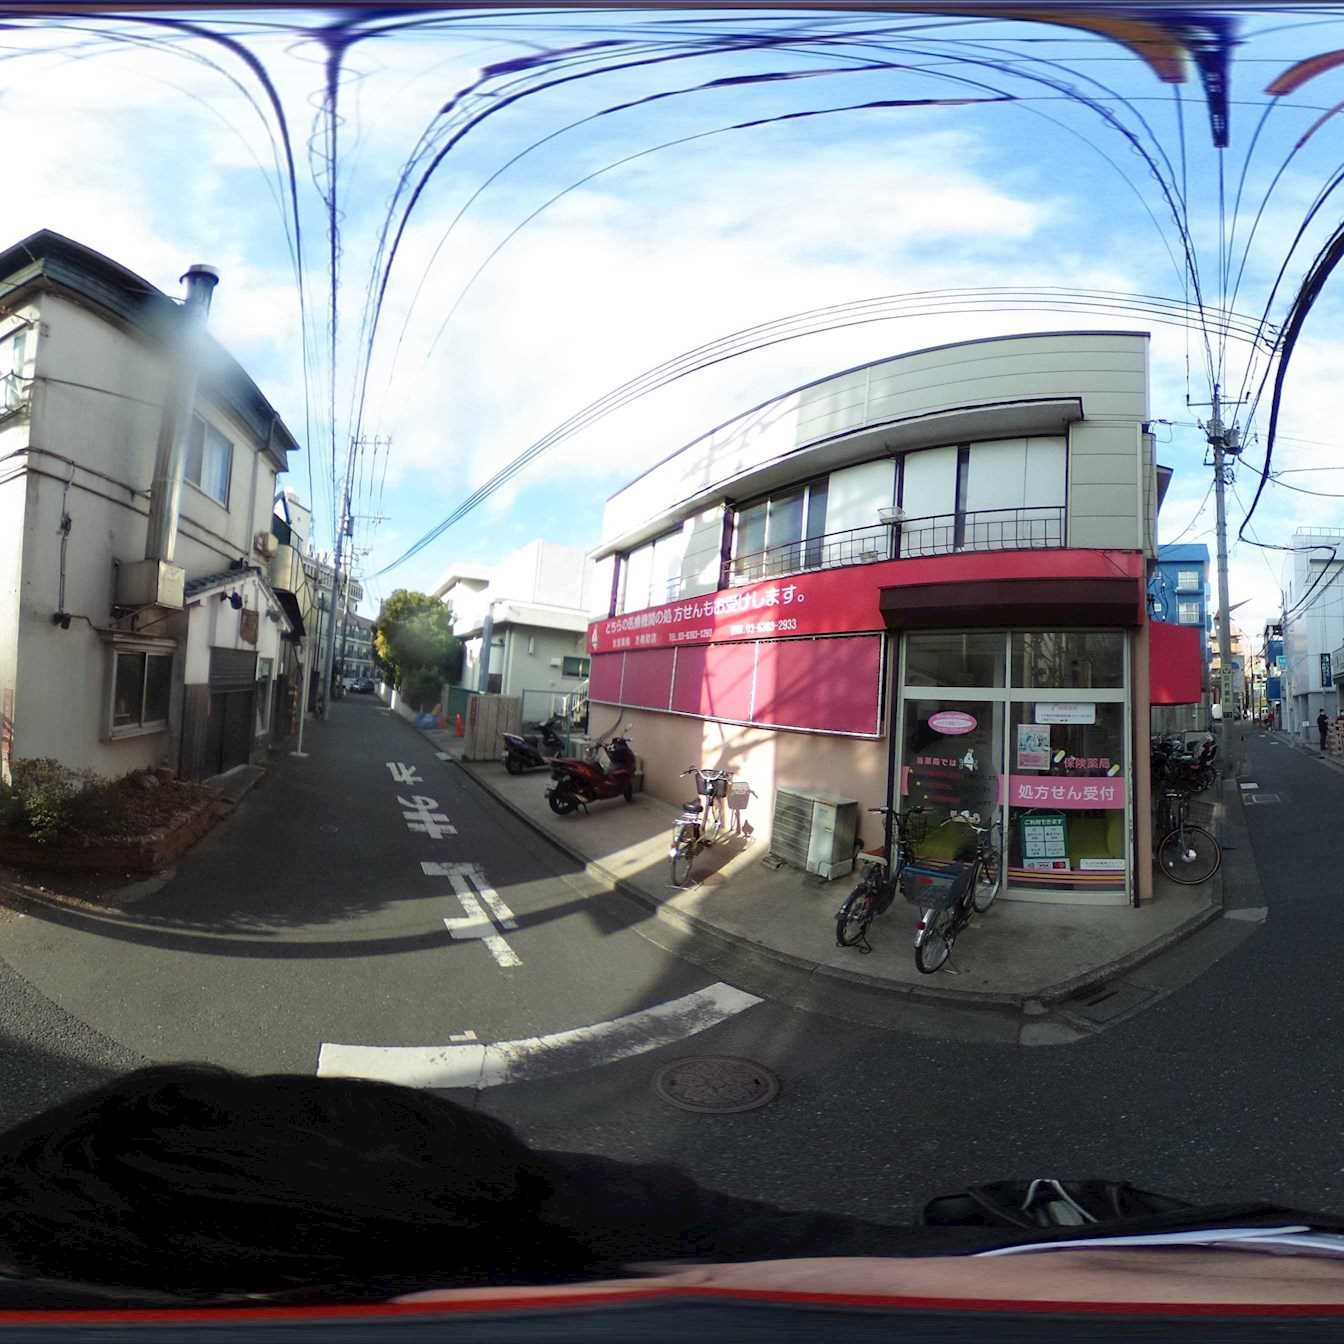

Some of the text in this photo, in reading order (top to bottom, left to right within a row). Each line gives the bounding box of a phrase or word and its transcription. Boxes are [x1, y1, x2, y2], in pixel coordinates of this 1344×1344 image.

[1064, 757, 1111, 769] 保険薬局
[1018, 784, 1115, 802] 処方せん受付
